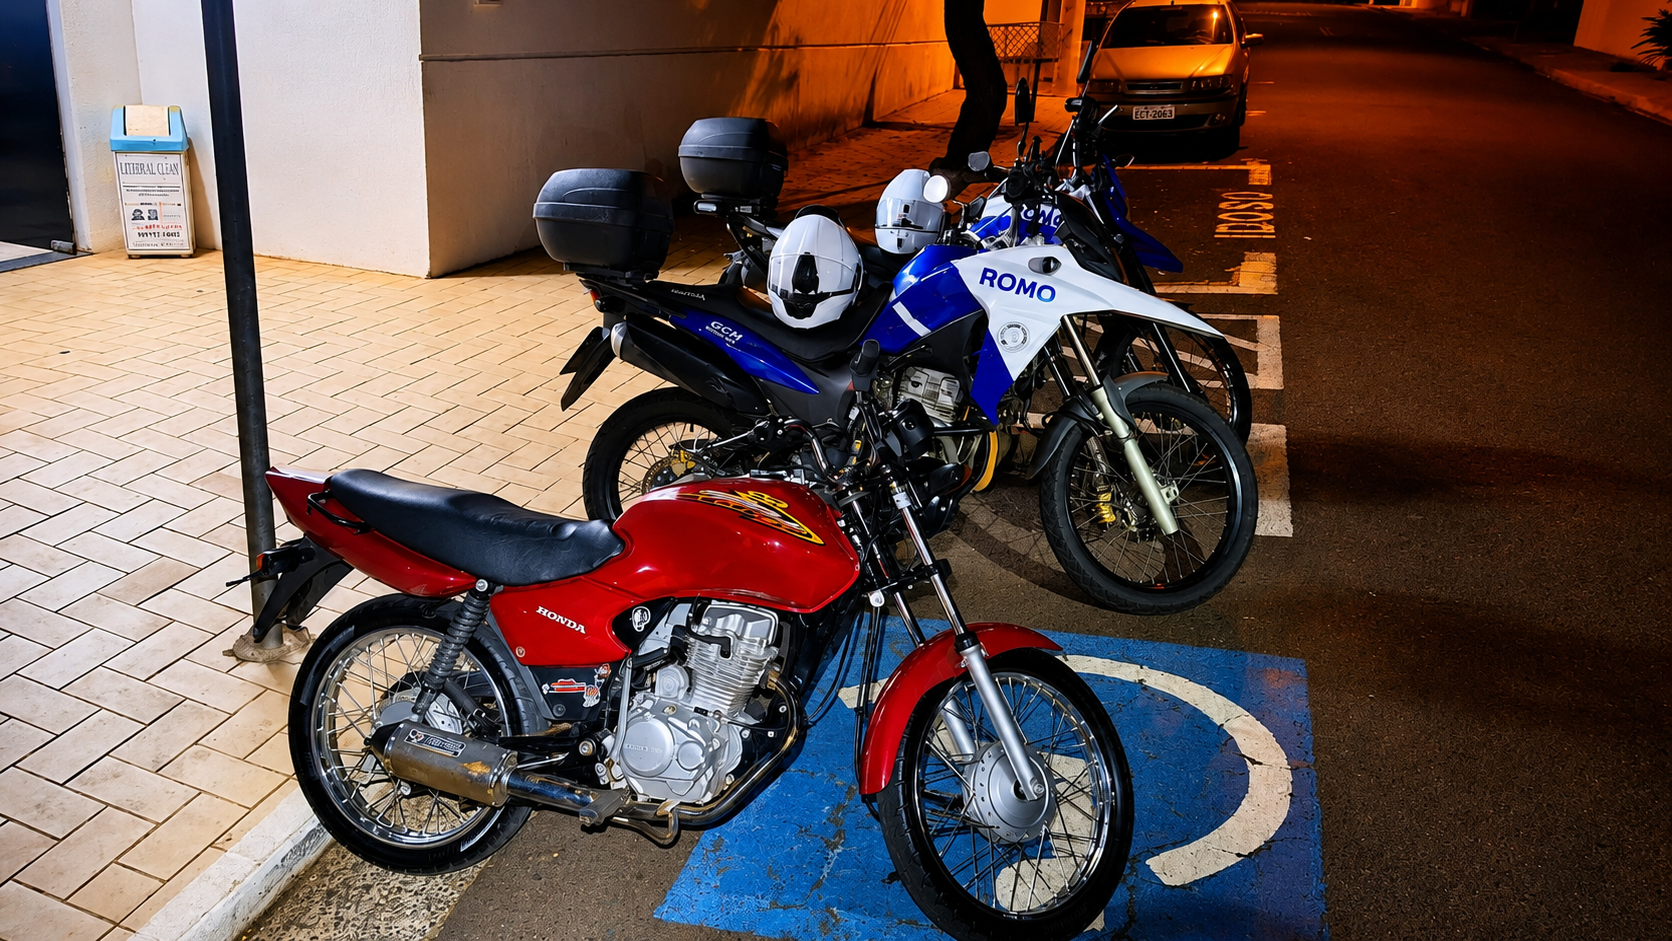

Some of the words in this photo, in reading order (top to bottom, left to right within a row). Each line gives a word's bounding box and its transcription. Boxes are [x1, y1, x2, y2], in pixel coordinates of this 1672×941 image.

[1214, 191, 1276, 238] IDOSO
[979, 267, 1056, 303] ROMO
[710, 320, 744, 342] GCM
[535, 605, 586, 634] HONDA
